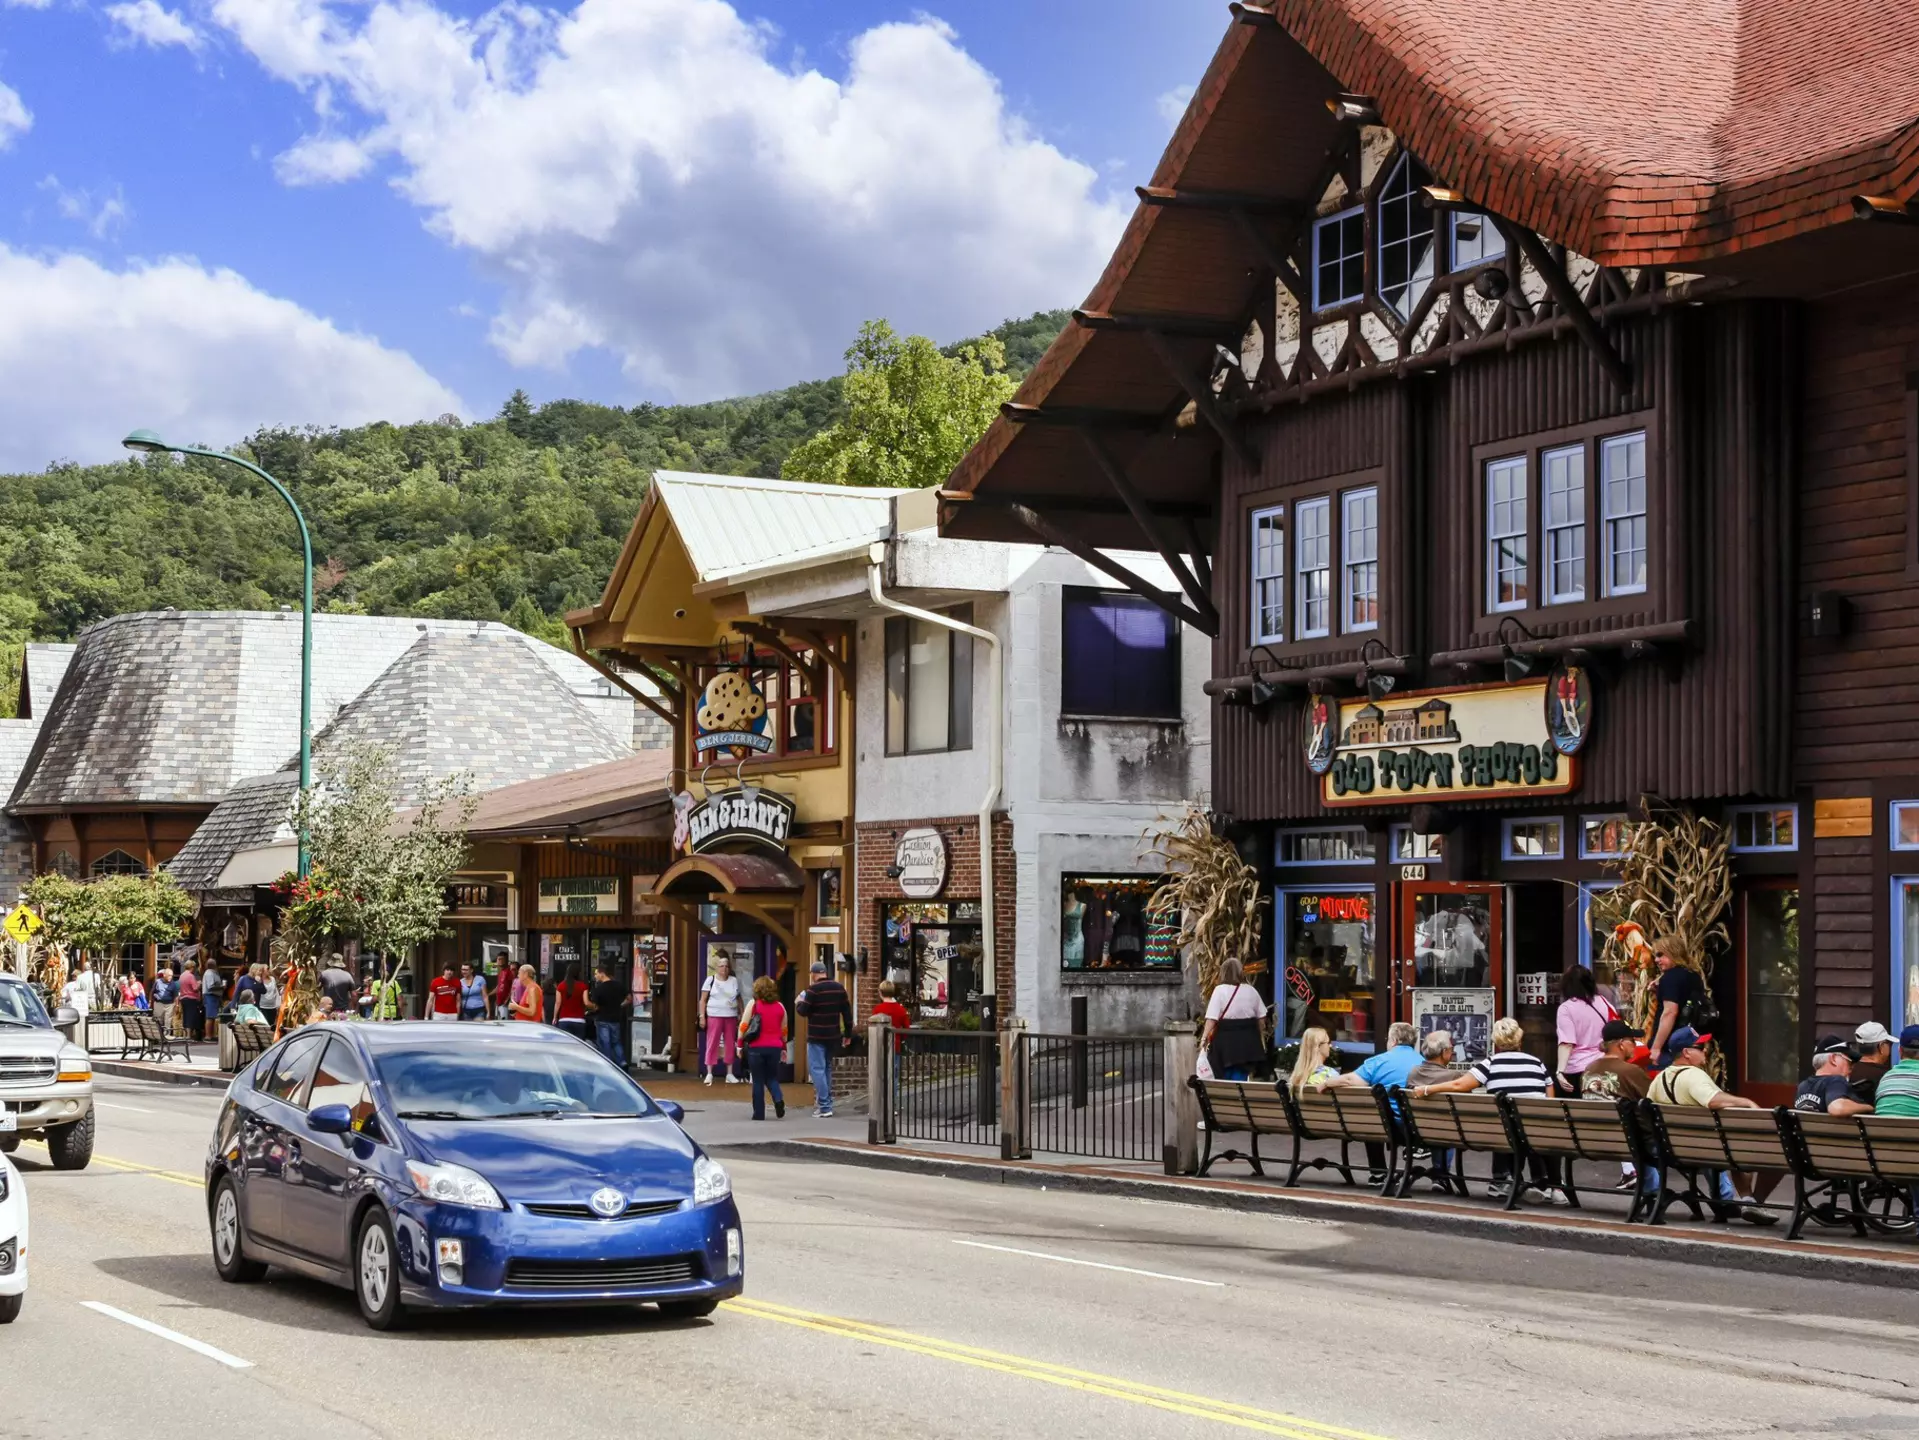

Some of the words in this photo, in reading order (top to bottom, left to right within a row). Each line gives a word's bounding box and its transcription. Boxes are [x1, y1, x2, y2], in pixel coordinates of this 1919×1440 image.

[1331, 752, 1375, 796] OLD
[1378, 746, 1454, 792] TOWN
[1458, 739, 1558, 787] PHOTOS
[1403, 867, 1424, 879] 644
[1300, 896, 1318, 906] GOLD
[1319, 896, 1369, 920] MINING
[936, 945, 958, 958] OPEN
[1285, 966, 1315, 1006] OPEN
[1518, 976, 1542, 984] BUY
[1526, 995, 1560, 1004] FREE
[1458, 1004, 1474, 1012] ALIVE
